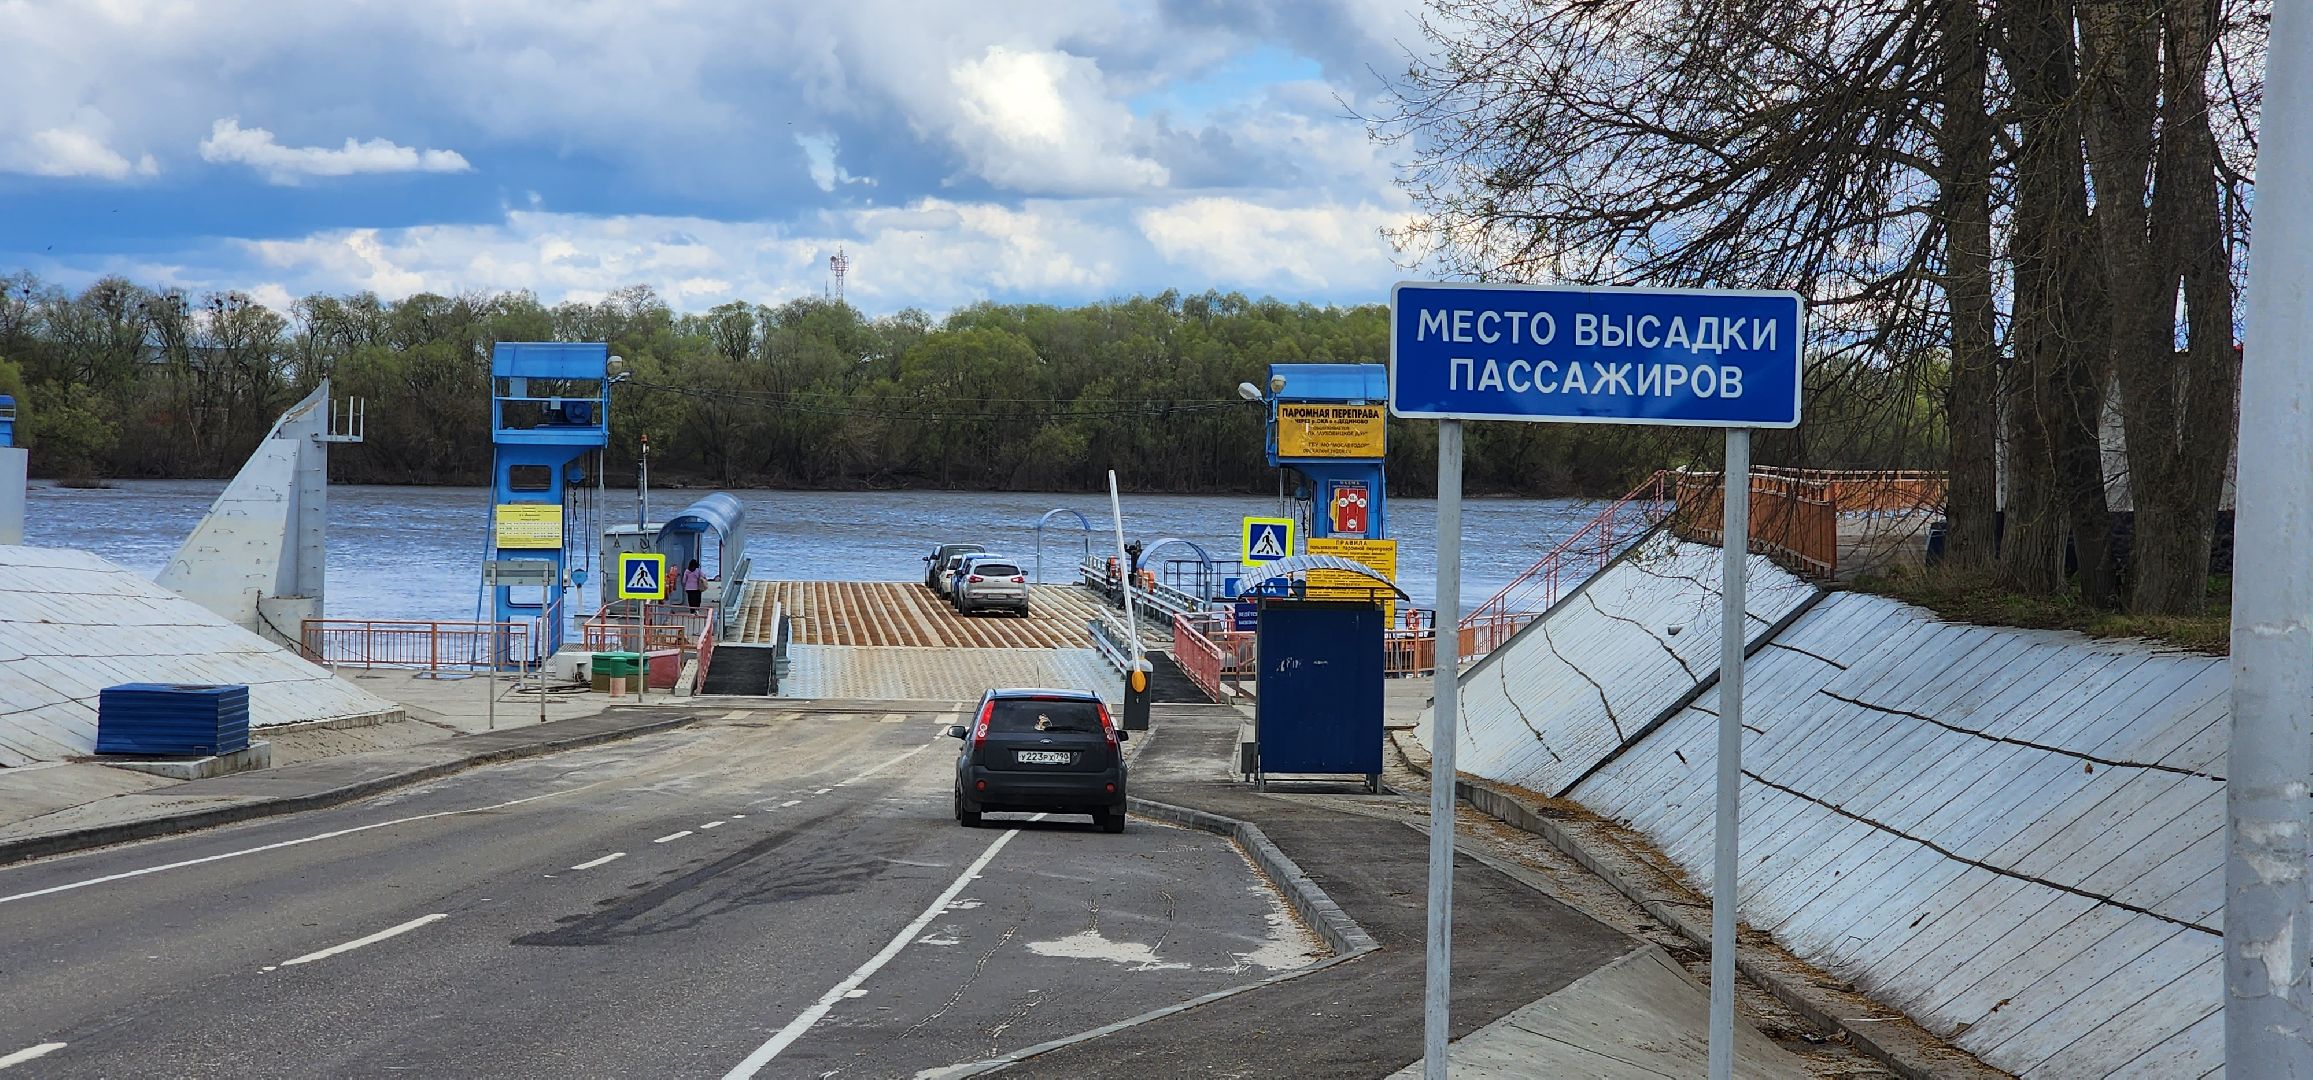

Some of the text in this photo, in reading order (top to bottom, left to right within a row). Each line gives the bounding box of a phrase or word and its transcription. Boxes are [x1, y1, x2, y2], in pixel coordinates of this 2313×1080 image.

[1416, 308, 1777, 354] МЕСТО ВЫСАДКИ
[1449, 357, 1743, 399] ПАССАЖИРОВ
[1282, 408, 1380, 418] ПАРОМНАЯ ПЕРЕПРАВА
